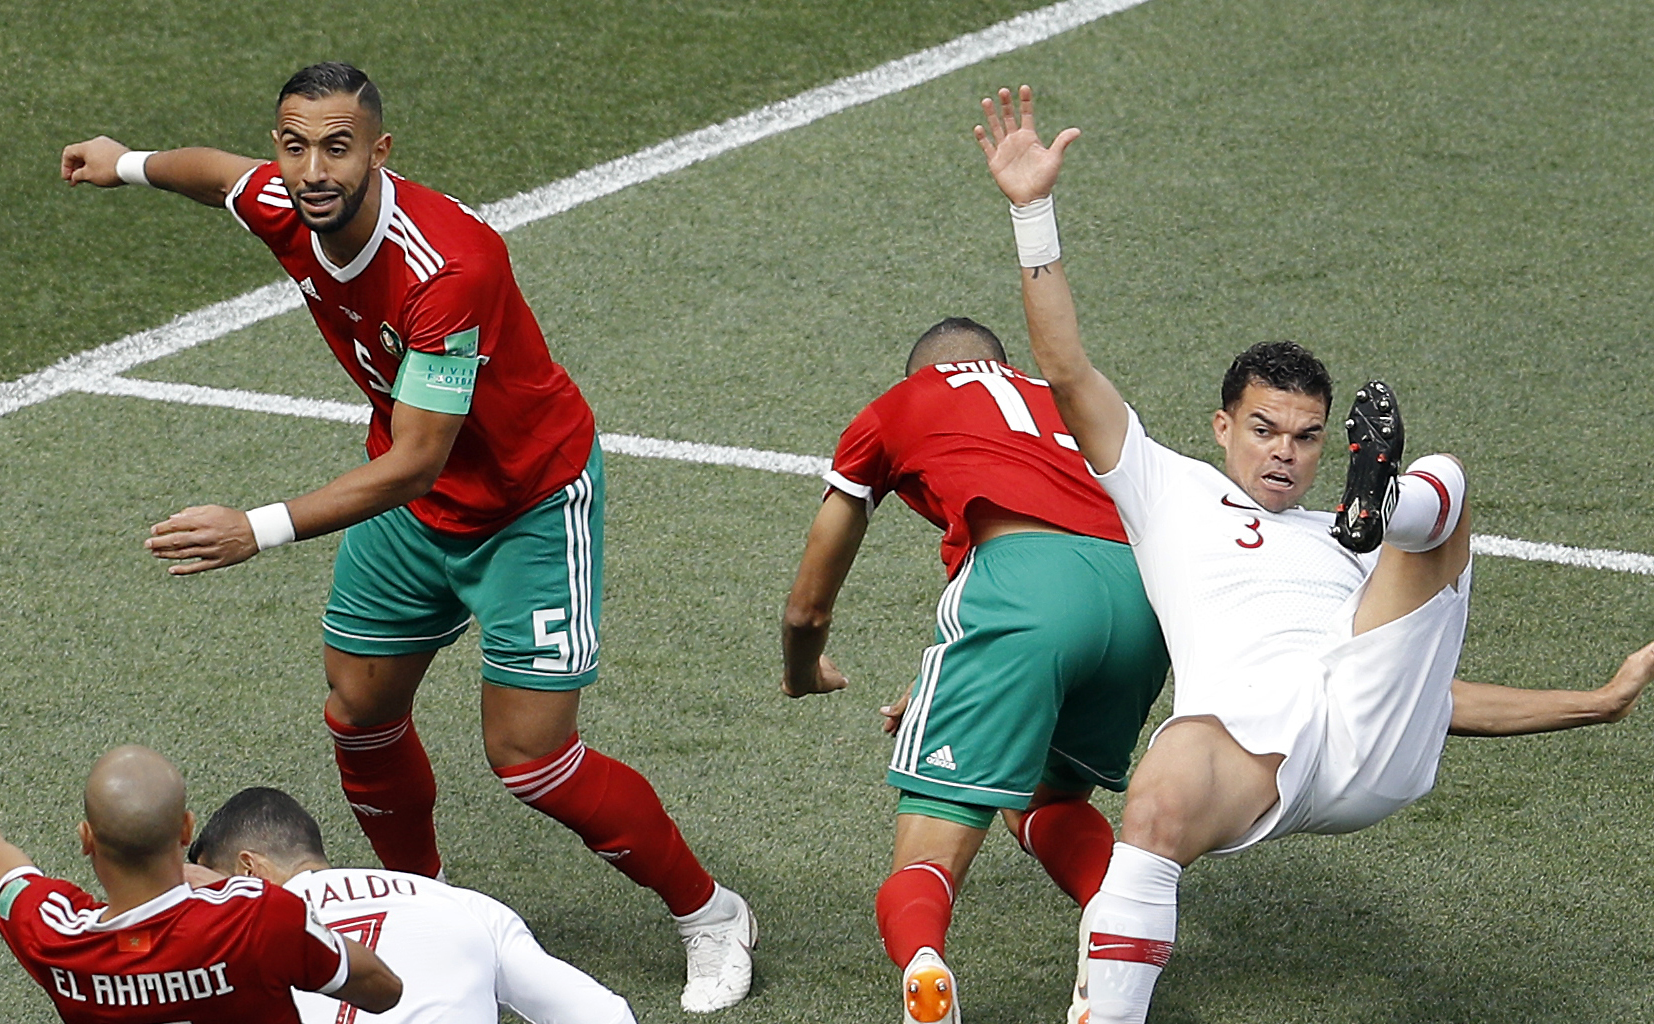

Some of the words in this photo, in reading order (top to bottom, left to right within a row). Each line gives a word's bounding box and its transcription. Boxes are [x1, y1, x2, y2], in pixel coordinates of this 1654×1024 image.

[352, 337, 393, 394] 5
[1235, 517, 1264, 549] 3
[532, 607, 570, 672] 5
[304, 874, 417, 909] ALDO
[49, 965, 87, 1002] EL
[91, 961, 235, 1007] AHMADI
